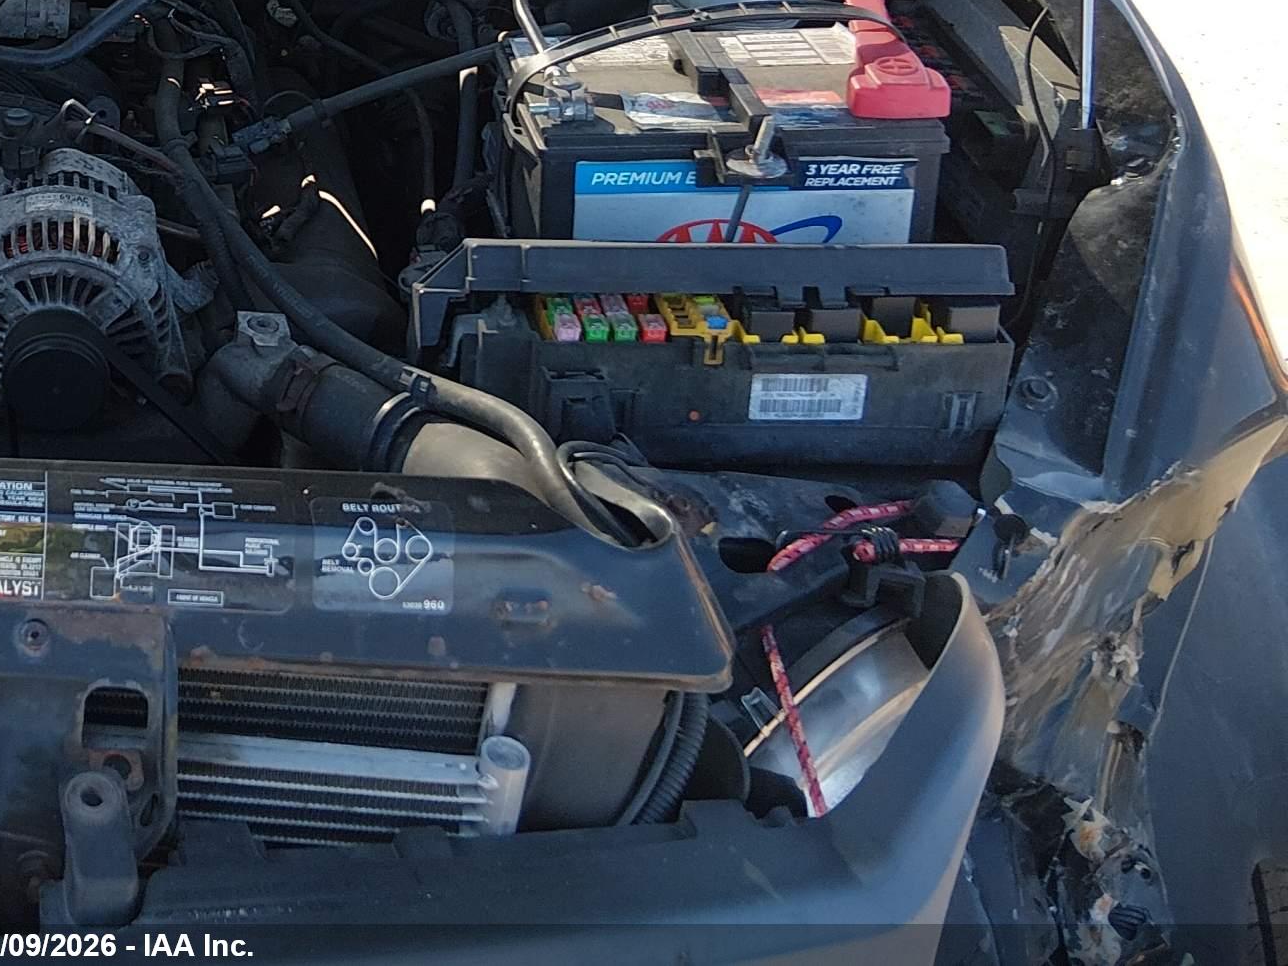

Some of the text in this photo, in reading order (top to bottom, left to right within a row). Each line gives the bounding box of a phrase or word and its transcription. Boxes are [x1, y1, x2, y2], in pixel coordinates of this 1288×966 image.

[805, 164, 904, 176] 3 YEAR FREE
[591, 171, 682, 186] PREMIUM
[804, 176, 897, 187] REPLACEMENT
[342, 503, 370, 512] BELT
